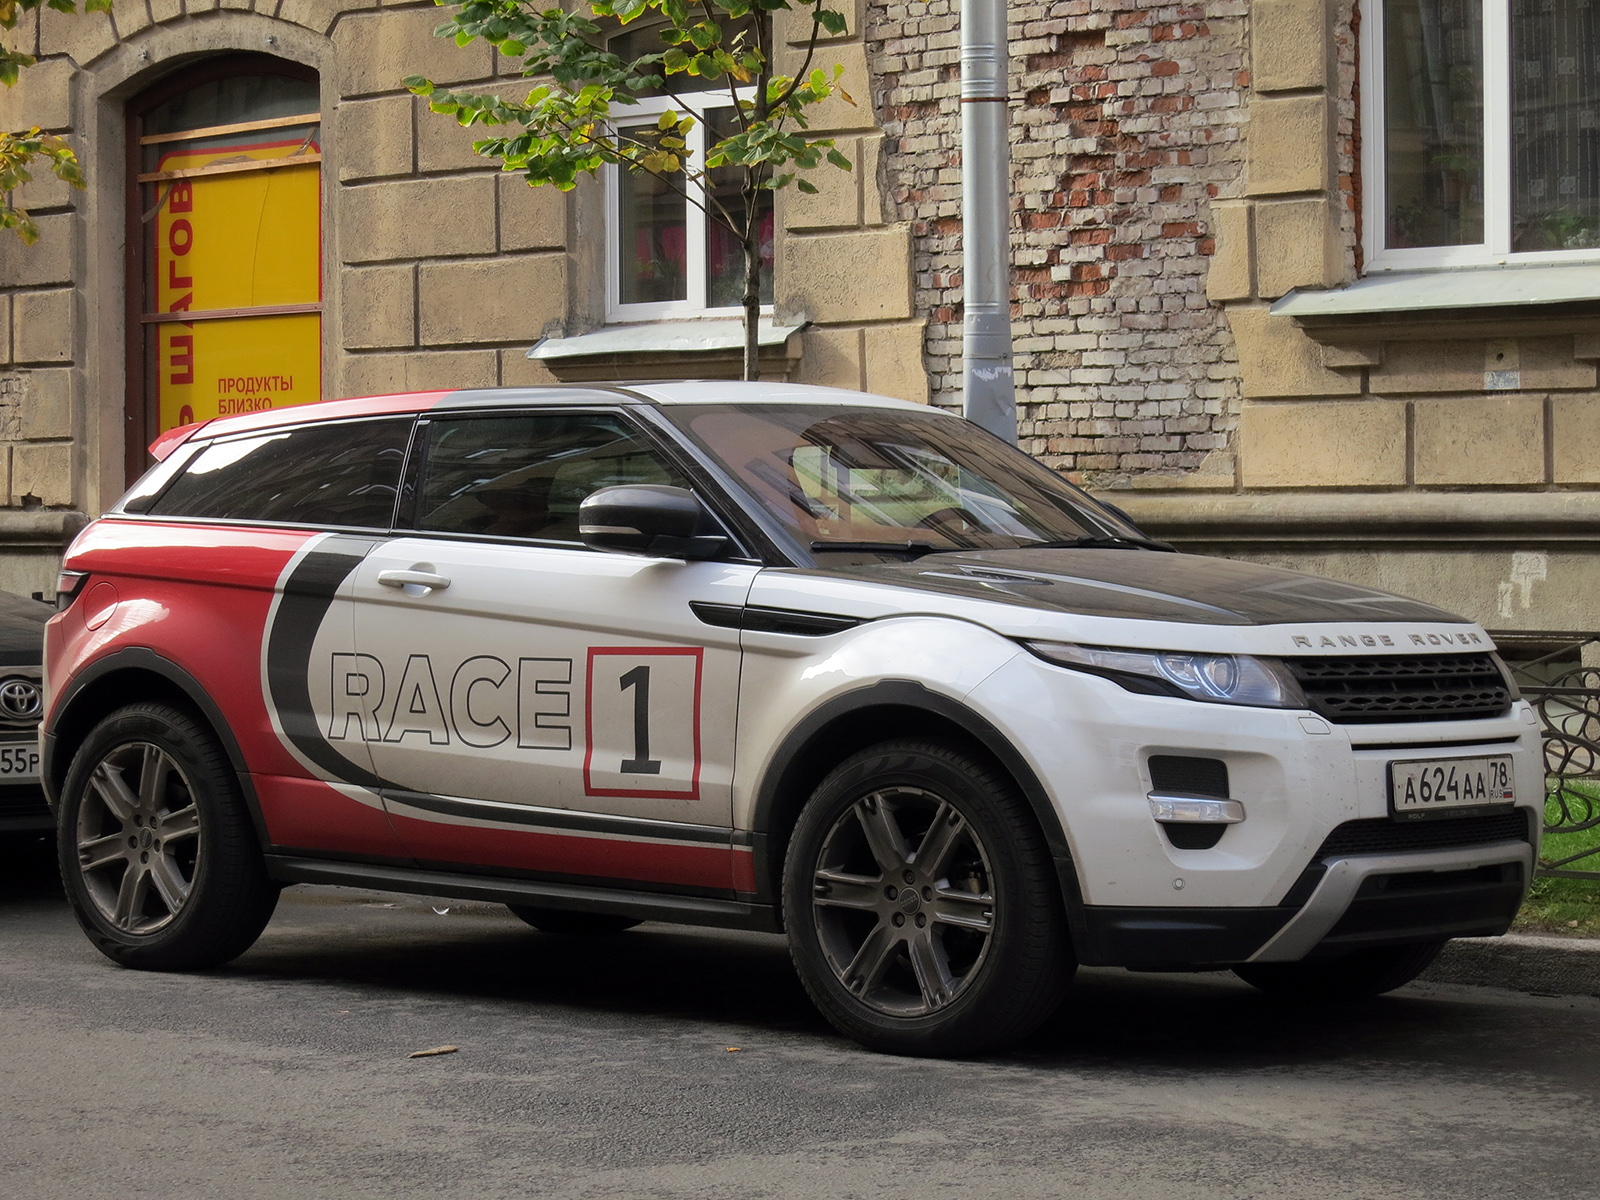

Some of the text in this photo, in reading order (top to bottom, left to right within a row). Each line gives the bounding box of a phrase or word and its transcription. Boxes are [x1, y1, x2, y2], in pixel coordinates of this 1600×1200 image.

[169, 180, 194, 385] ШАГОВ
[218, 376, 293, 395] ПРОДУКТЫ
[218, 397, 272, 414] БЛИЗКО
[1291, 632, 1482, 648] RANGE ROVER
[327, 652, 662, 774] RACE 1
[1490, 762, 1508, 788] 78
[1490, 789, 1503, 799] RUS
